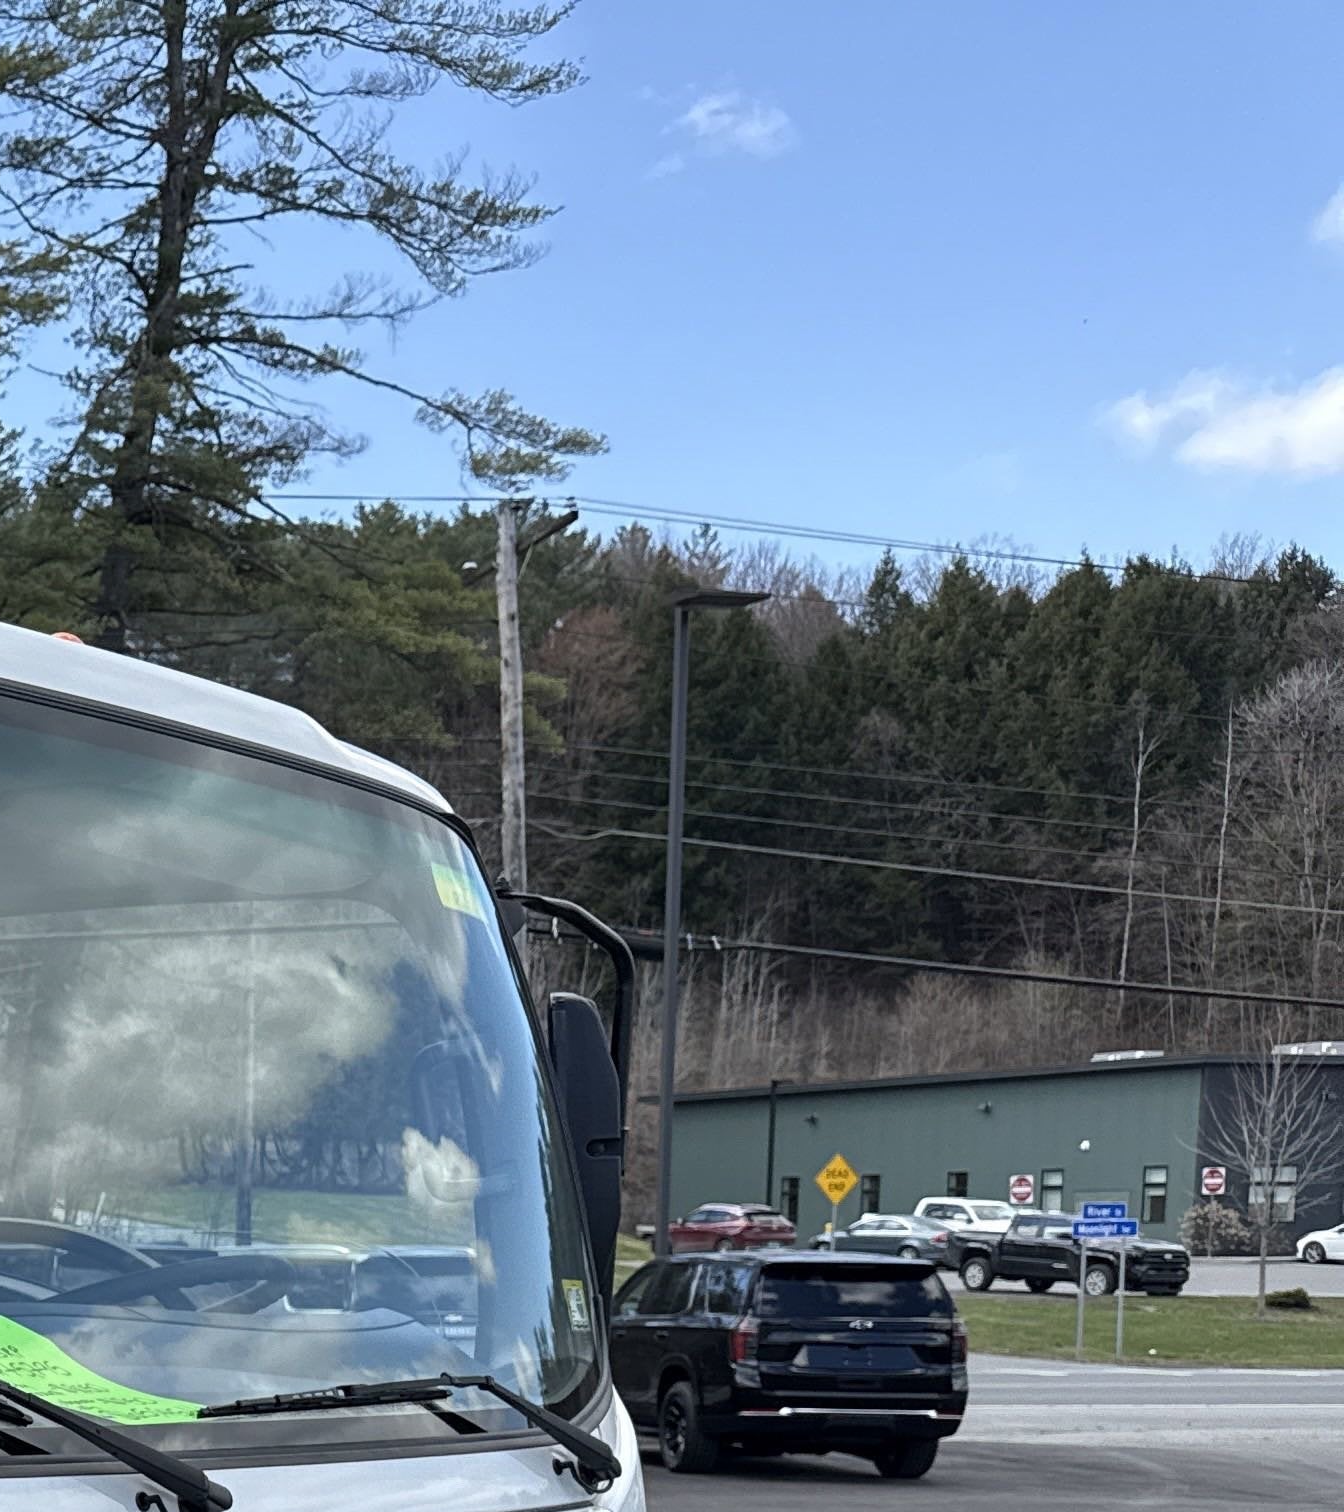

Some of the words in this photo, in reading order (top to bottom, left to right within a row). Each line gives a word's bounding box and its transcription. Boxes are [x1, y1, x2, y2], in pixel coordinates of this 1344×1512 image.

[826, 1168, 849, 1179] DEAD
[828, 1182, 846, 1192] END
[1087, 1206, 1111, 1217] River
